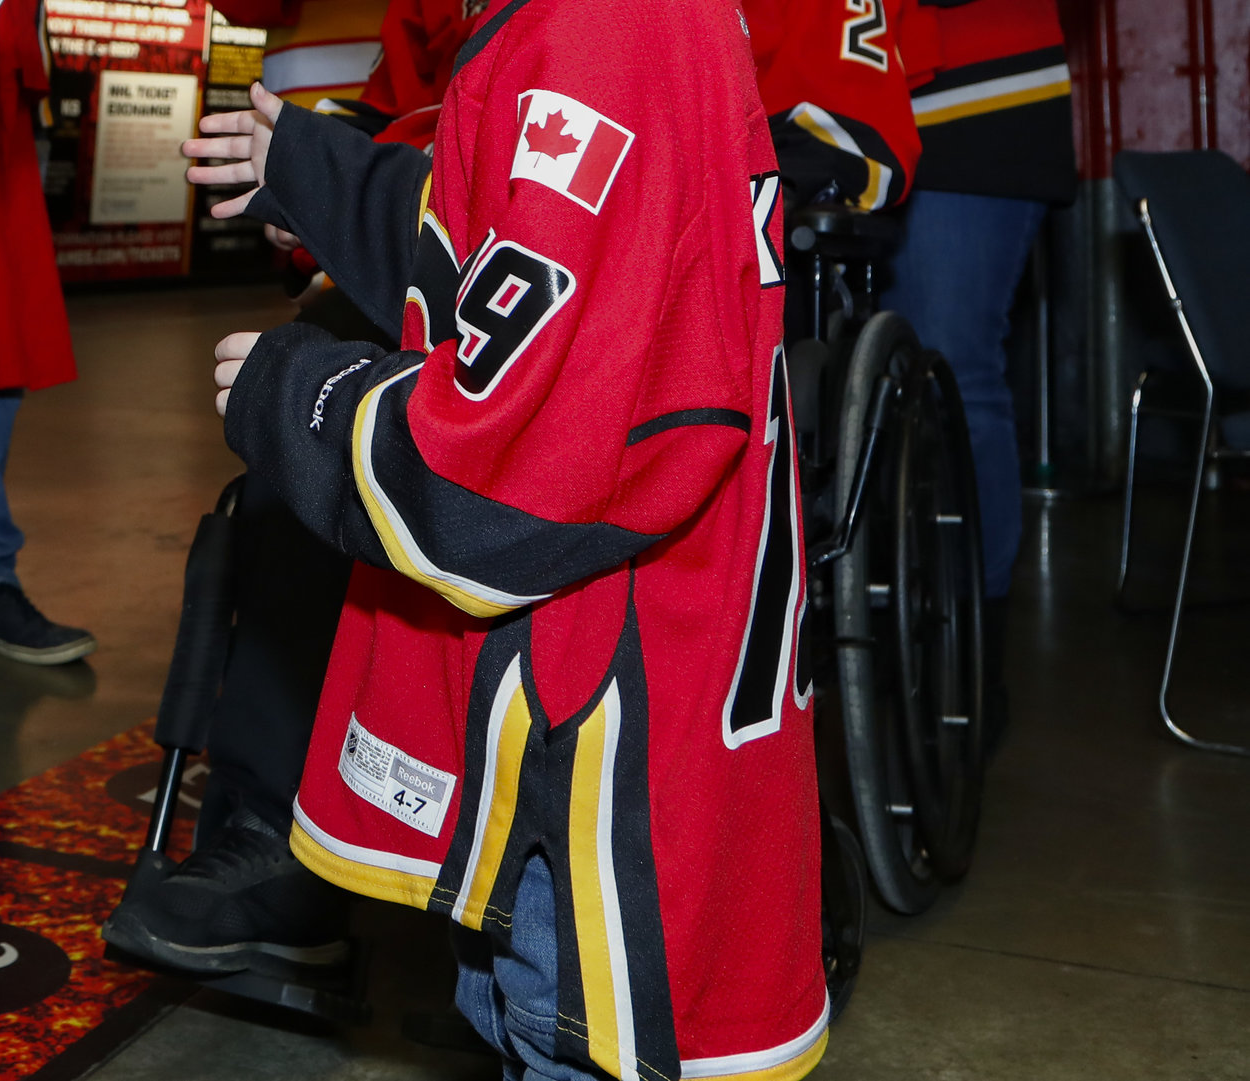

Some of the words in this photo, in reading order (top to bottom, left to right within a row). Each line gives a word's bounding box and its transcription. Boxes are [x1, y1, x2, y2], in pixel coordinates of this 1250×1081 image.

[108, 83, 133, 98] NHL
[136, 85, 178, 101] TICKET
[106, 101, 173, 118] EXCHANGE
[309, 358, 372, 432] Reebok
[397, 765, 437, 796] Reebok
[393, 789, 428, 815] 4-7
